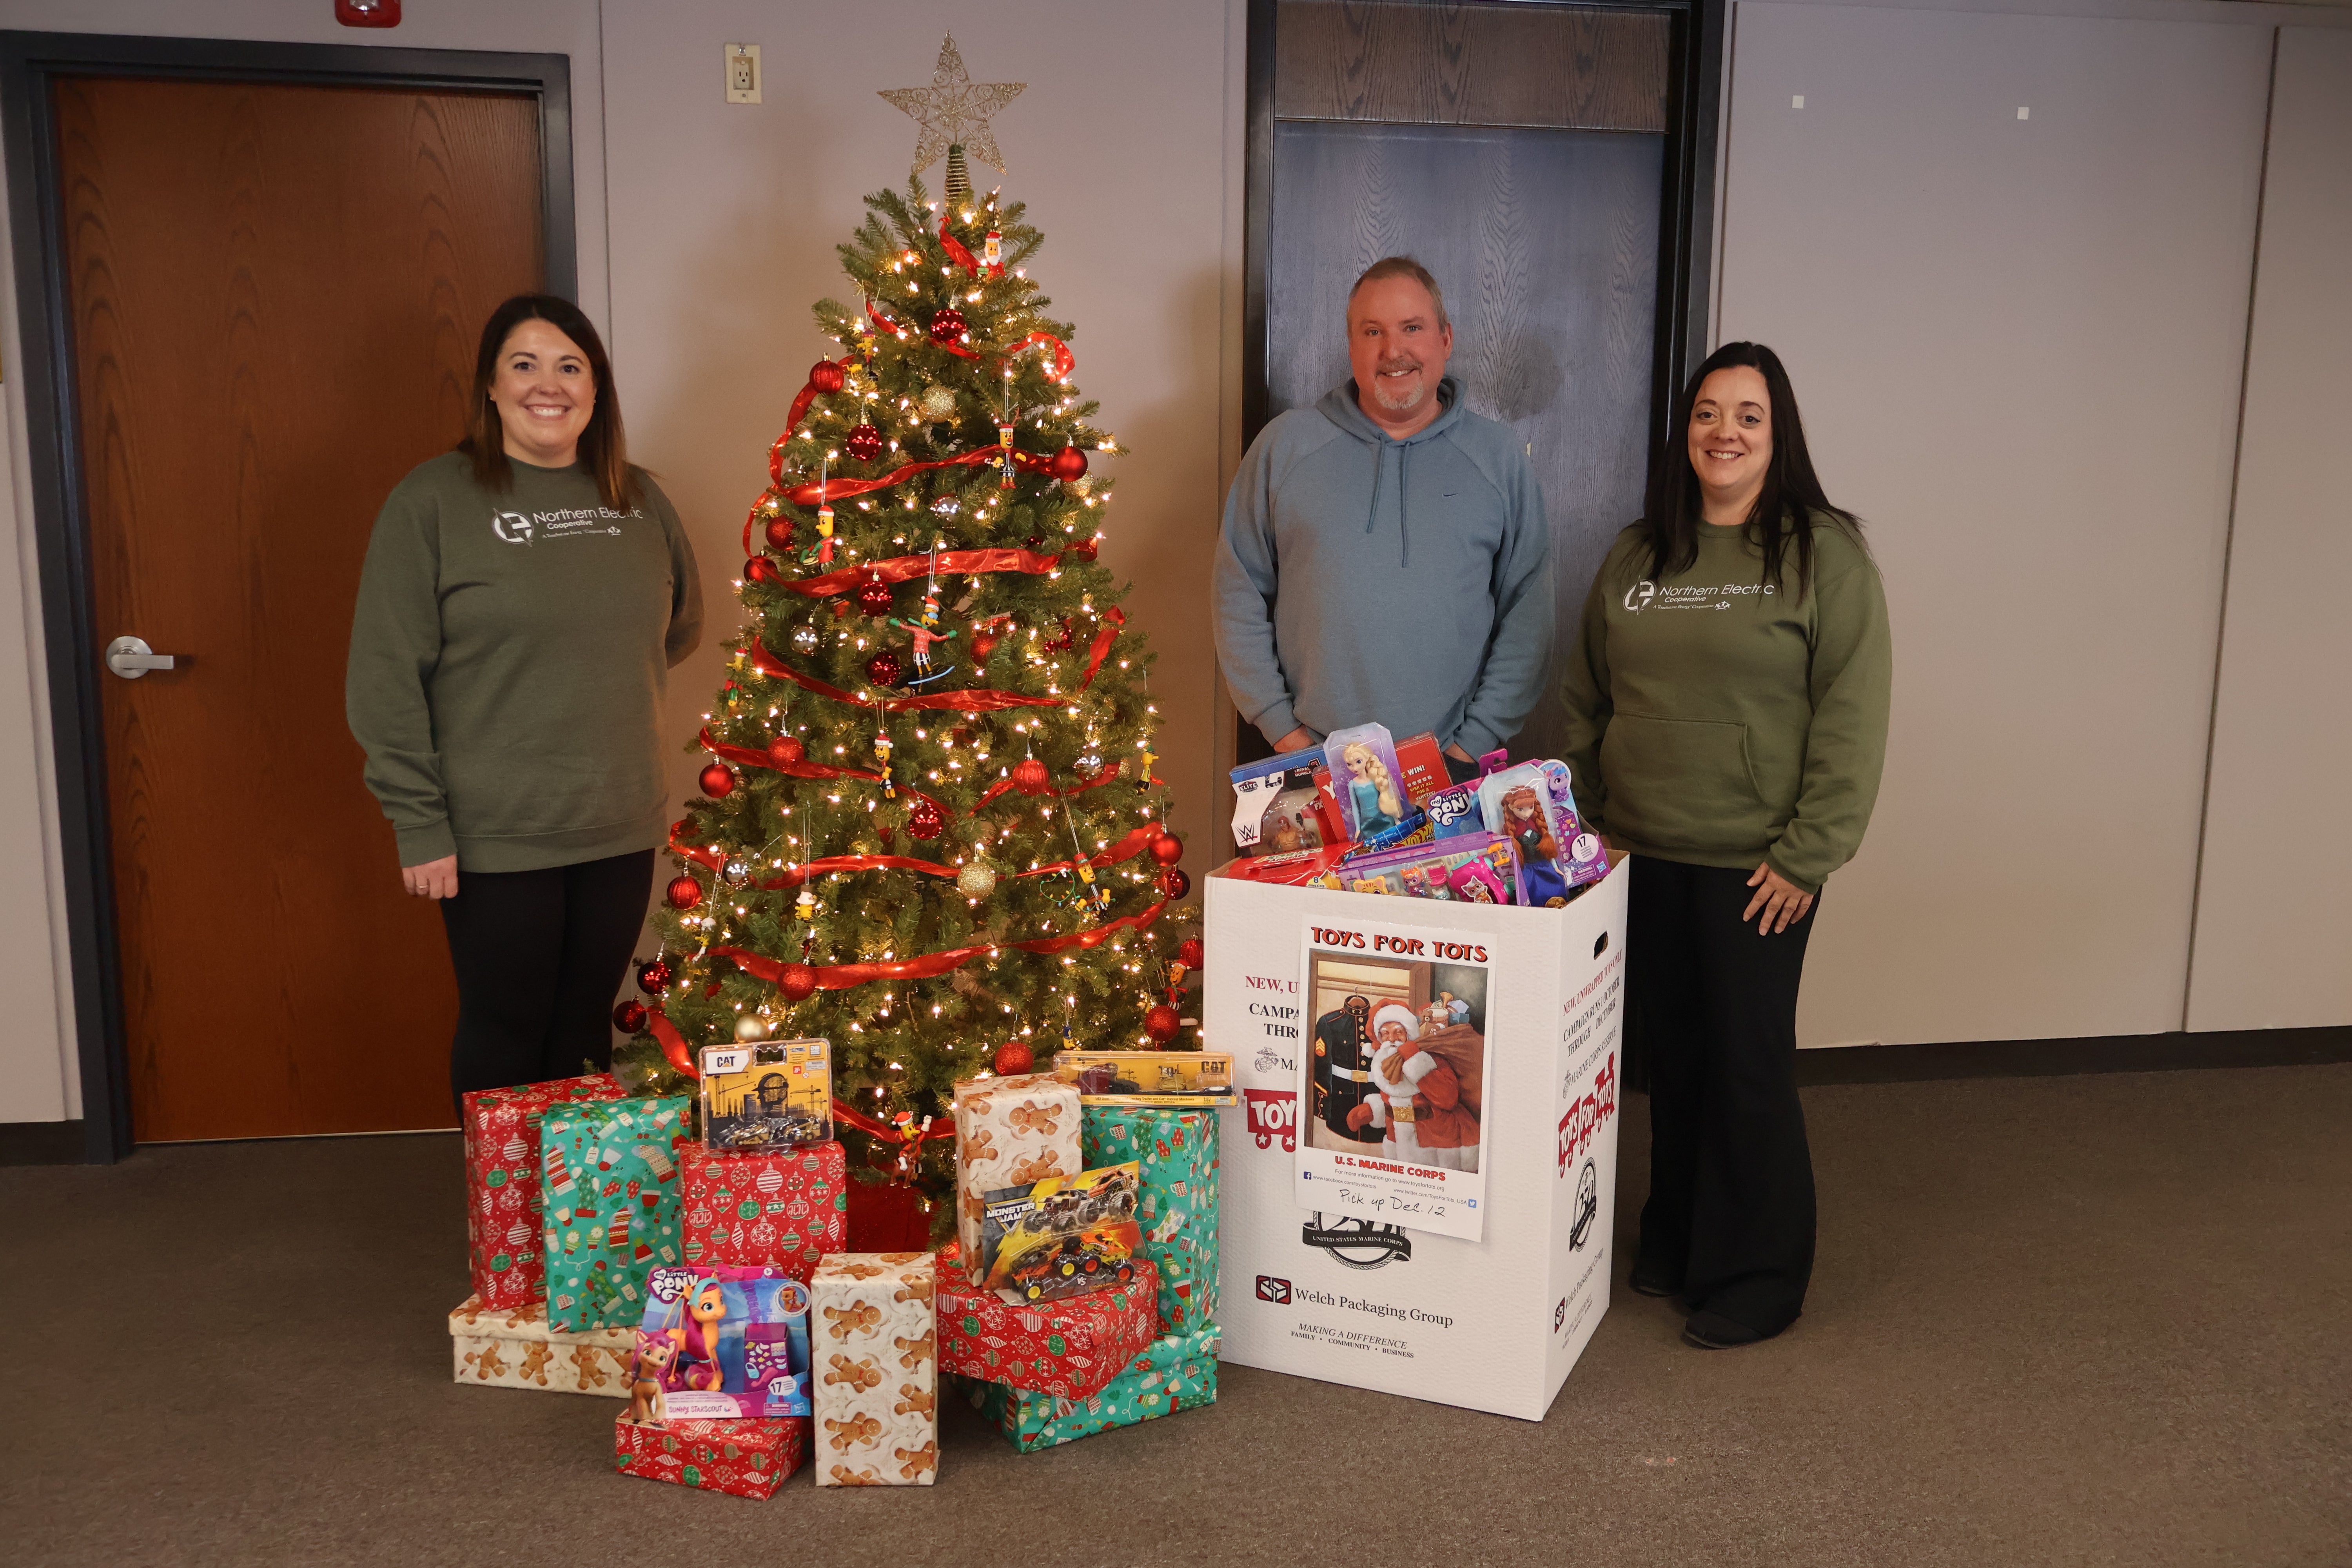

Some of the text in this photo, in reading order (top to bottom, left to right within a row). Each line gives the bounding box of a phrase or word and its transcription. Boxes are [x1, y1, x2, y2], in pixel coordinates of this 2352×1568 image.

[533, 508, 597, 524] Northern
[547, 520, 593, 529] Cooperative
[1659, 585, 1718, 596] Northern
[1407, 765, 1425, 776] WIN!
[1240, 783, 1258, 791] ELITE
[1577, 835, 1586, 848] 17
[1311, 926, 1488, 962] TOYS FOR TOTS
[1245, 975, 1283, 994] NEW,
[1577, 970, 1604, 1004] UNWRAPPED
[1563, 1009, 1589, 1042] CAMPAIGN
[1603, 976, 1620, 1004] OCTOBER
[1264, 1023, 1298, 1039] THR
[1568, 998, 1615, 1057] THROUGH DECEMBER
[717, 1056, 735, 1067] CAT
[1570, 1026, 1617, 1086] MARINE CORPS RESERVE
[1201, 1061, 1226, 1073] CAT
[1250, 1099, 1297, 1129] TOY
[1559, 1077, 1612, 1154] TOYS FOR TOTS
[1335, 1156, 1446, 1181] U.S. MARINE CORPS
[1313, 1175, 1376, 1189] www.facebook.com/toysfortots
[1357, 1172, 1384, 1181] information
[1398, 1179, 1445, 1192] www.toysfortots.org
[1339, 1189, 1445, 1217] Pick up Dec. 12
[1393, 1188, 1467, 1205] www.twitter.com/ToysForTots_USA
[986, 1202, 1035, 1218] MONSTER
[1000, 1212, 1022, 1223] JAM
[1383, 1238, 1403, 1247] CORPS
[1295, 1288, 1453, 1328] Welch Packaging Group
[1291, 1331, 1414, 1358] FAMILY COMMUNITY BUSINESS
[1298, 1323, 1336, 1336] MAKING
[1346, 1332, 1407, 1349] DIFFERENCE
[771, 1382, 782, 1393] 17
